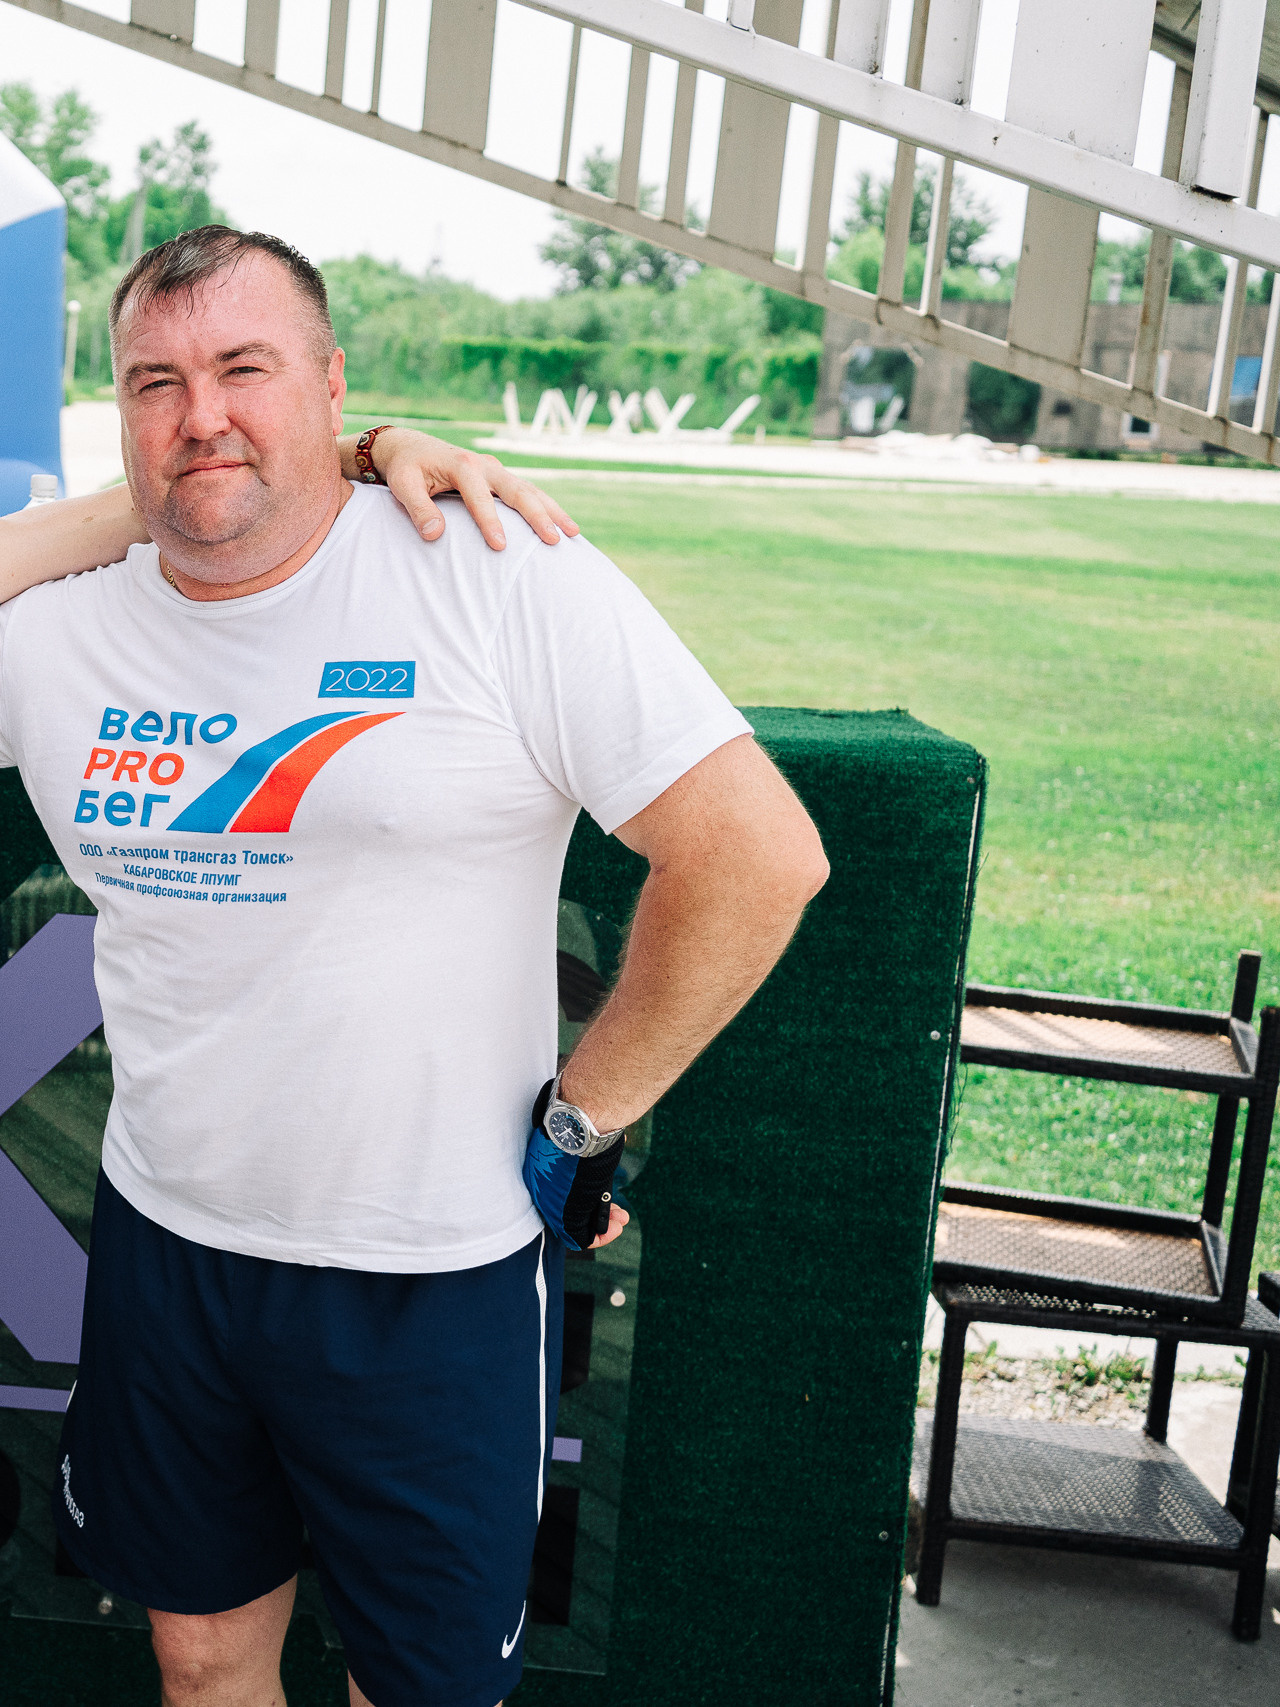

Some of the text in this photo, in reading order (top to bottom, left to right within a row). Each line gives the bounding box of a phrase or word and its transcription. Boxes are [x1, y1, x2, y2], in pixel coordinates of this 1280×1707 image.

[324, 667, 408, 692] 2022
[83, 747, 185, 786] PRO
[79, 843, 295, 866] ООО «Газпром трансгаз Томск»
[122, 863, 242, 886] ХАБАРОВСКОЕ ЛПУМГ
[95, 872, 287, 904] Первичная профсоюзная организация
